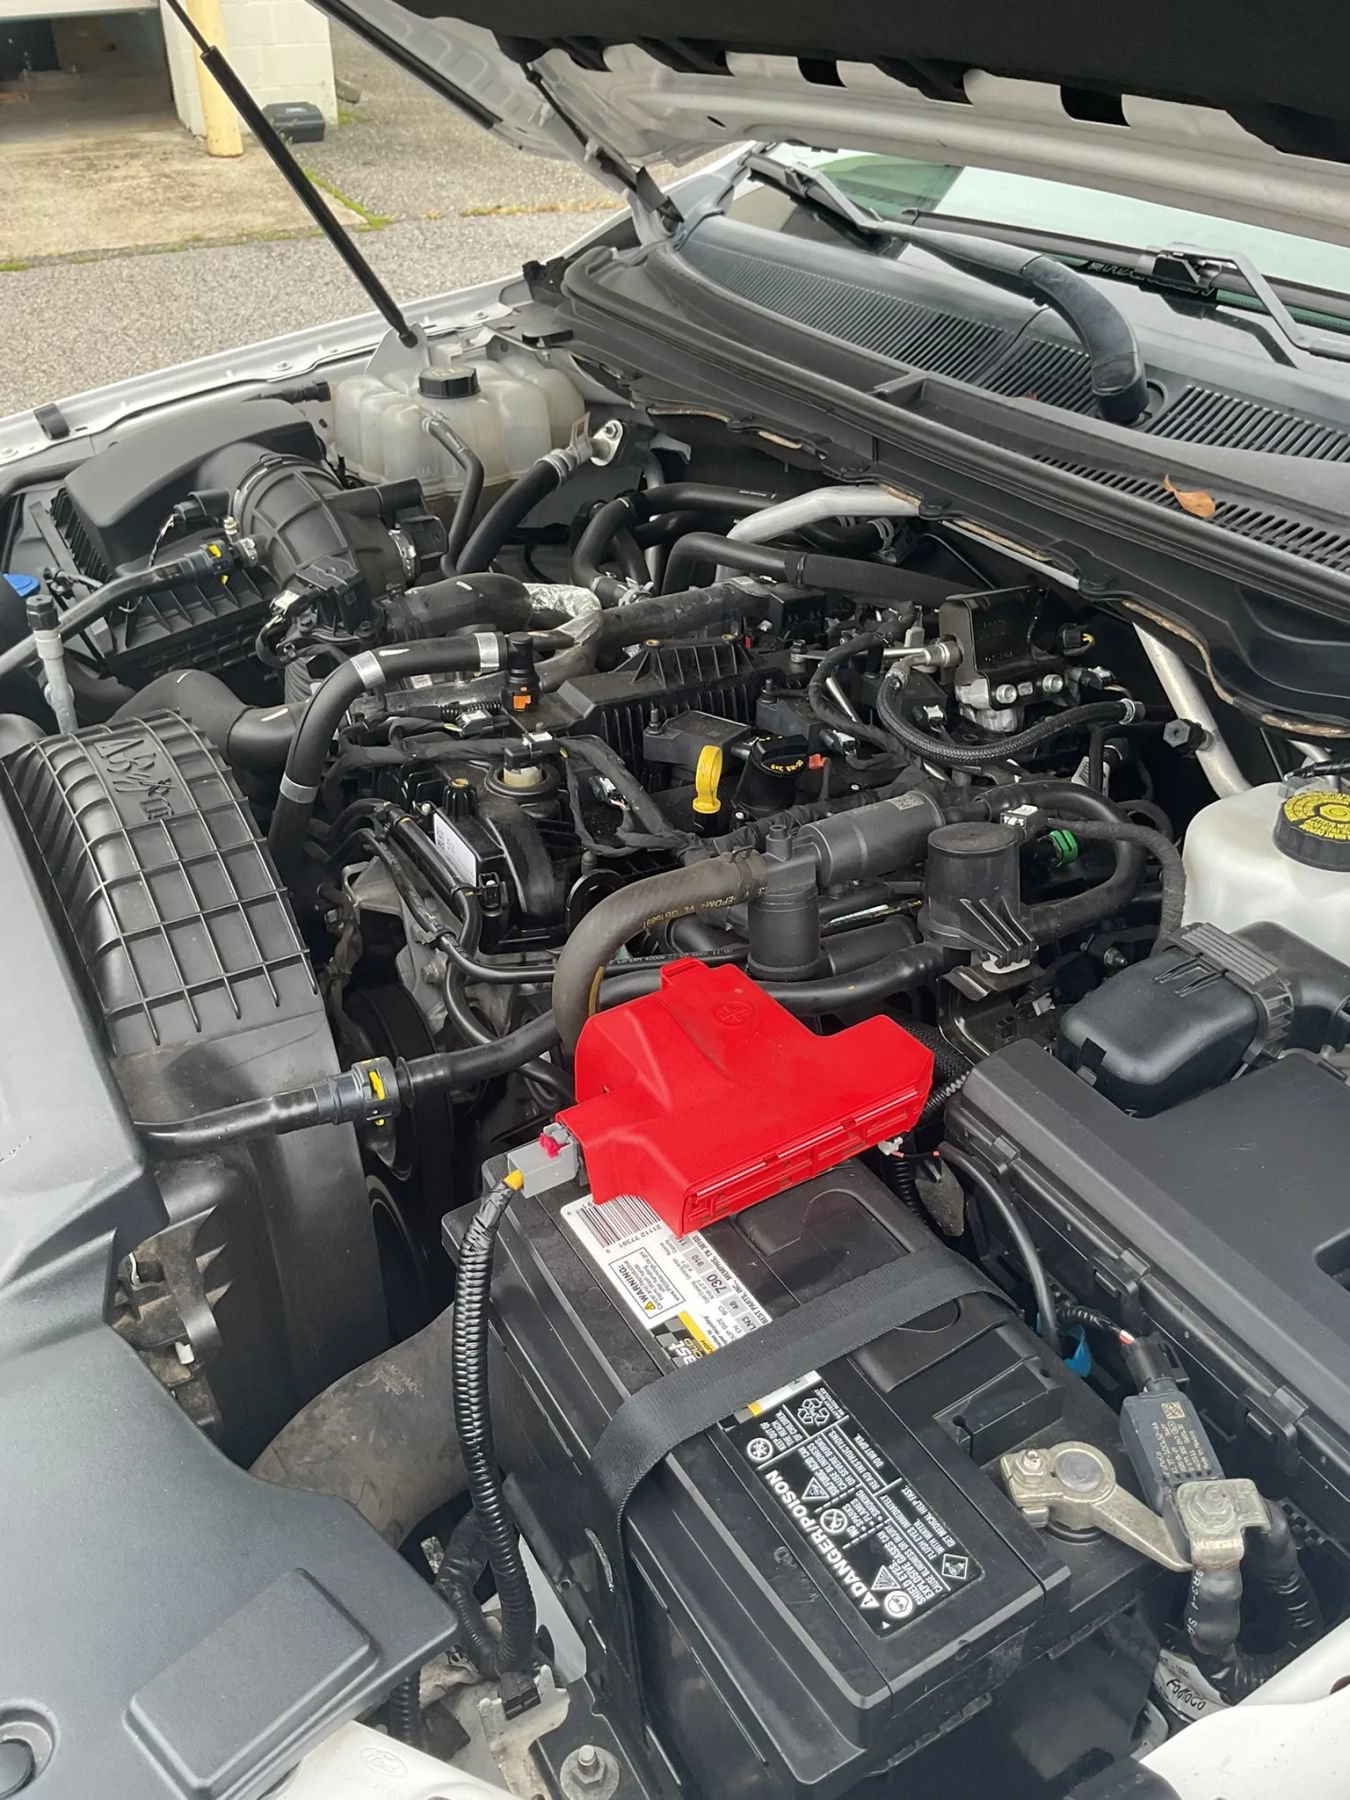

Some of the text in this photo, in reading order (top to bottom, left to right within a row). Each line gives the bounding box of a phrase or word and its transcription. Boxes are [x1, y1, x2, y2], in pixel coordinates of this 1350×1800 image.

[677, 1237, 688, 1247] 11
[690, 1253, 705, 1267] 910
[708, 1255, 733, 1281] MEMPHIS,
[615, 1263, 649, 1303] WARNING:
[704, 1272, 728, 1294] 730
[728, 1299, 740, 1310] 48
[740, 1315, 757, 1331] LN3
[666, 1338, 697, 1368] ast
[682, 1336, 704, 1359] OLD
[759, 1420, 787, 1451] KEEP OUT OF
[770, 1419, 794, 1446] THE REACH
[791, 1432, 803, 1442] OF
[825, 1427, 880, 1490] READ INSTRUCTIONS.
[826, 1452, 849, 1477] SEVERE
[863, 1446, 877, 1459] NOT
[871, 1456, 884, 1467] DO
[796, 1445, 840, 1496] SULFURIC ACID CAN
[805, 1442, 848, 1490] CAUSE BLINDNESS
[843, 1474, 856, 1485] OR
[840, 1502, 864, 1527] SPARKS
[849, 1497, 873, 1522] FLAMES
[855, 1488, 881, 1516] SMOKING
[878, 1493, 937, 1560] FLUSH EYES IMMEDIATELY
[899, 1484, 956, 1547] GET MEDICAL HELP FAST.
[764, 1468, 869, 1598] DANGER/POISON
[844, 1524, 860, 1538] NO
[911, 1517, 945, 1554] WITH WATER.
[875, 1529, 935, 1599] EXPLOSIVE GASES CAN
[882, 1522, 944, 1593] CAUSE BLINDNESS OR INJURY.
[885, 1558, 926, 1605] SHIELD EYES.
